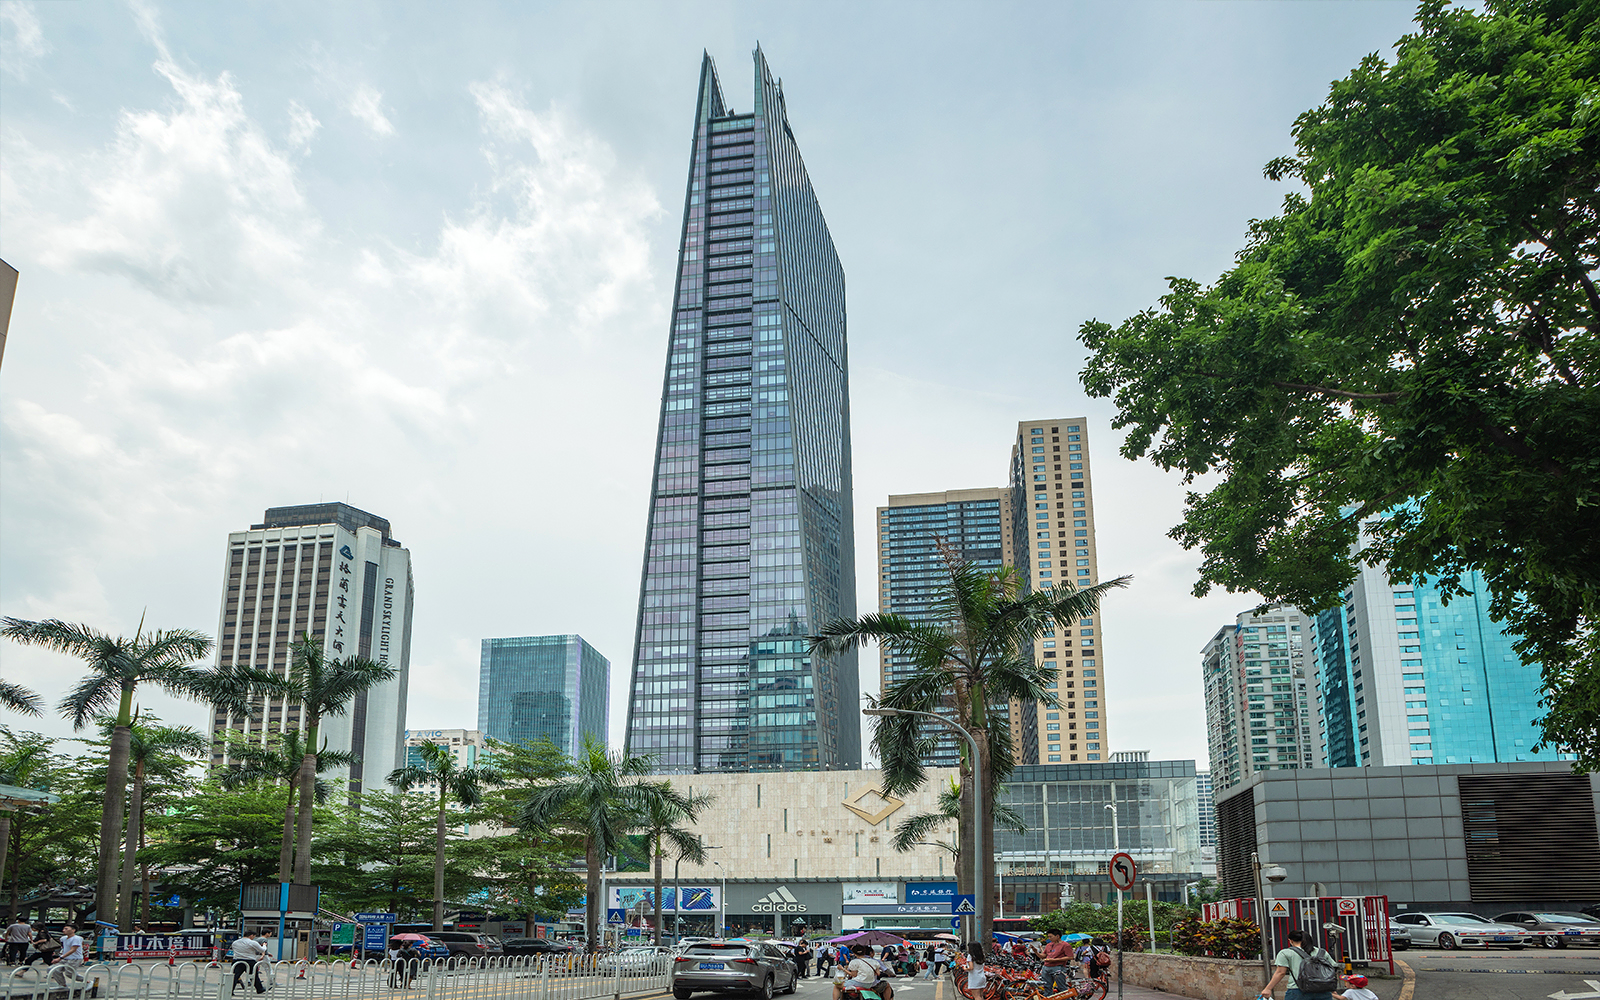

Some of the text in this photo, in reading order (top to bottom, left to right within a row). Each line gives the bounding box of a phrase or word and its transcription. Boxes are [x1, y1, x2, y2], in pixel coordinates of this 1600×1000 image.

[383, 577, 394, 609] GRAND
[380, 609, 392, 652] SKYLIGHT
[416, 730, 443, 738] AVIC
[796, 828, 878, 838] CENTURY
[751, 902, 807, 912] adidas
[334, 923, 341, 931] P
[123, 936, 204, 951] 山木培训
